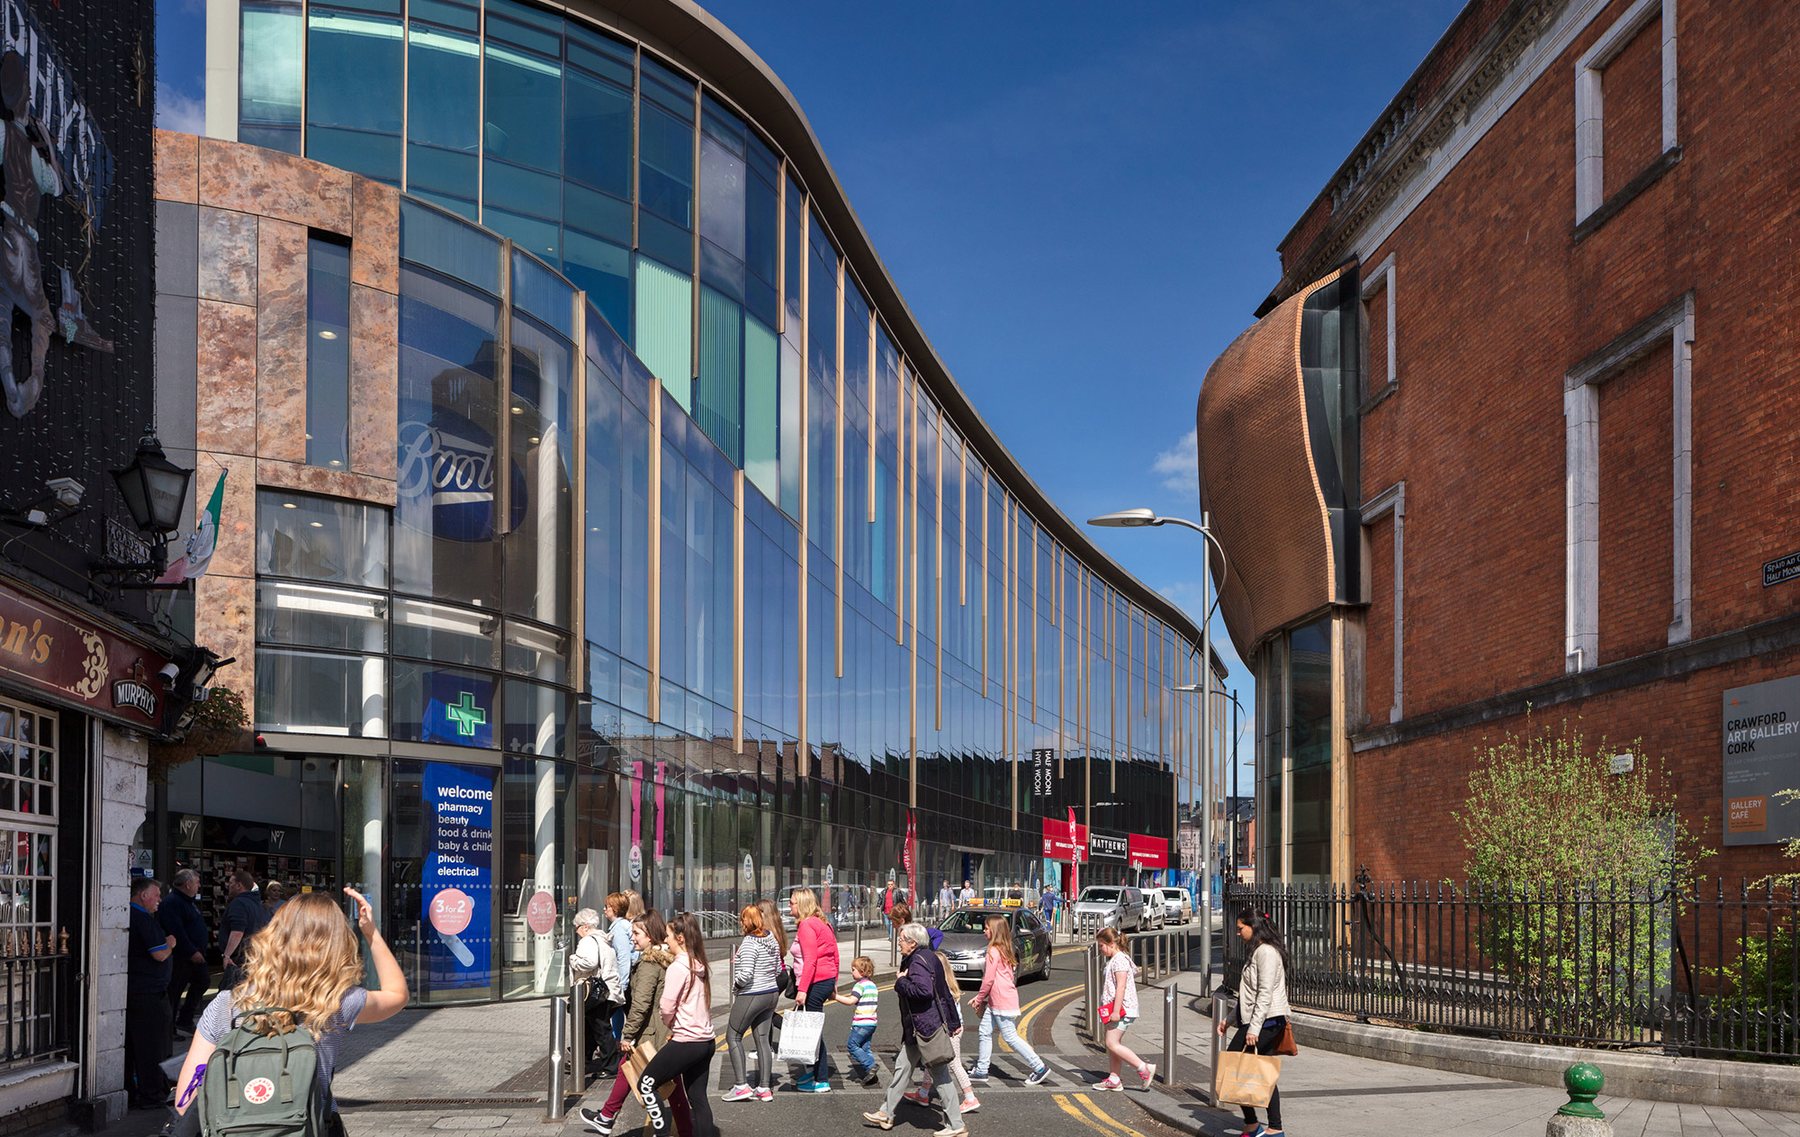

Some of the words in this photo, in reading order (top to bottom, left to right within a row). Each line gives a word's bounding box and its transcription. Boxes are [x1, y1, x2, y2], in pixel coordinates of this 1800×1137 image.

[397, 420, 494, 505] Boot
[1766, 570, 1781, 583] HALF
[117, 683, 156, 714] MURPHYS
[1727, 711, 1787, 731] CRAWFORD
[1727, 729, 1747, 744] ART
[1750, 721, 1800, 740] GALLERY
[1727, 741, 1756, 755] CORK
[437, 785, 493, 801] welcome
[438, 801, 484, 815] pharmacy
[1731, 799, 1762, 810] GALLERY
[438, 815, 469, 827] beauty
[437, 827, 459, 837] food
[461, 829, 468, 838] &
[470, 829, 492, 839] drink
[438, 840, 460, 852] baby
[462, 842, 469, 851] &
[471, 842, 492, 852] child
[438, 854, 465, 864] photo
[437, 866, 479, 876] electrical
[435, 899, 444, 913] 3
[445, 906, 457, 914] for
[457, 900, 465, 913] 2
[641, 1075, 664, 1129] adidas
